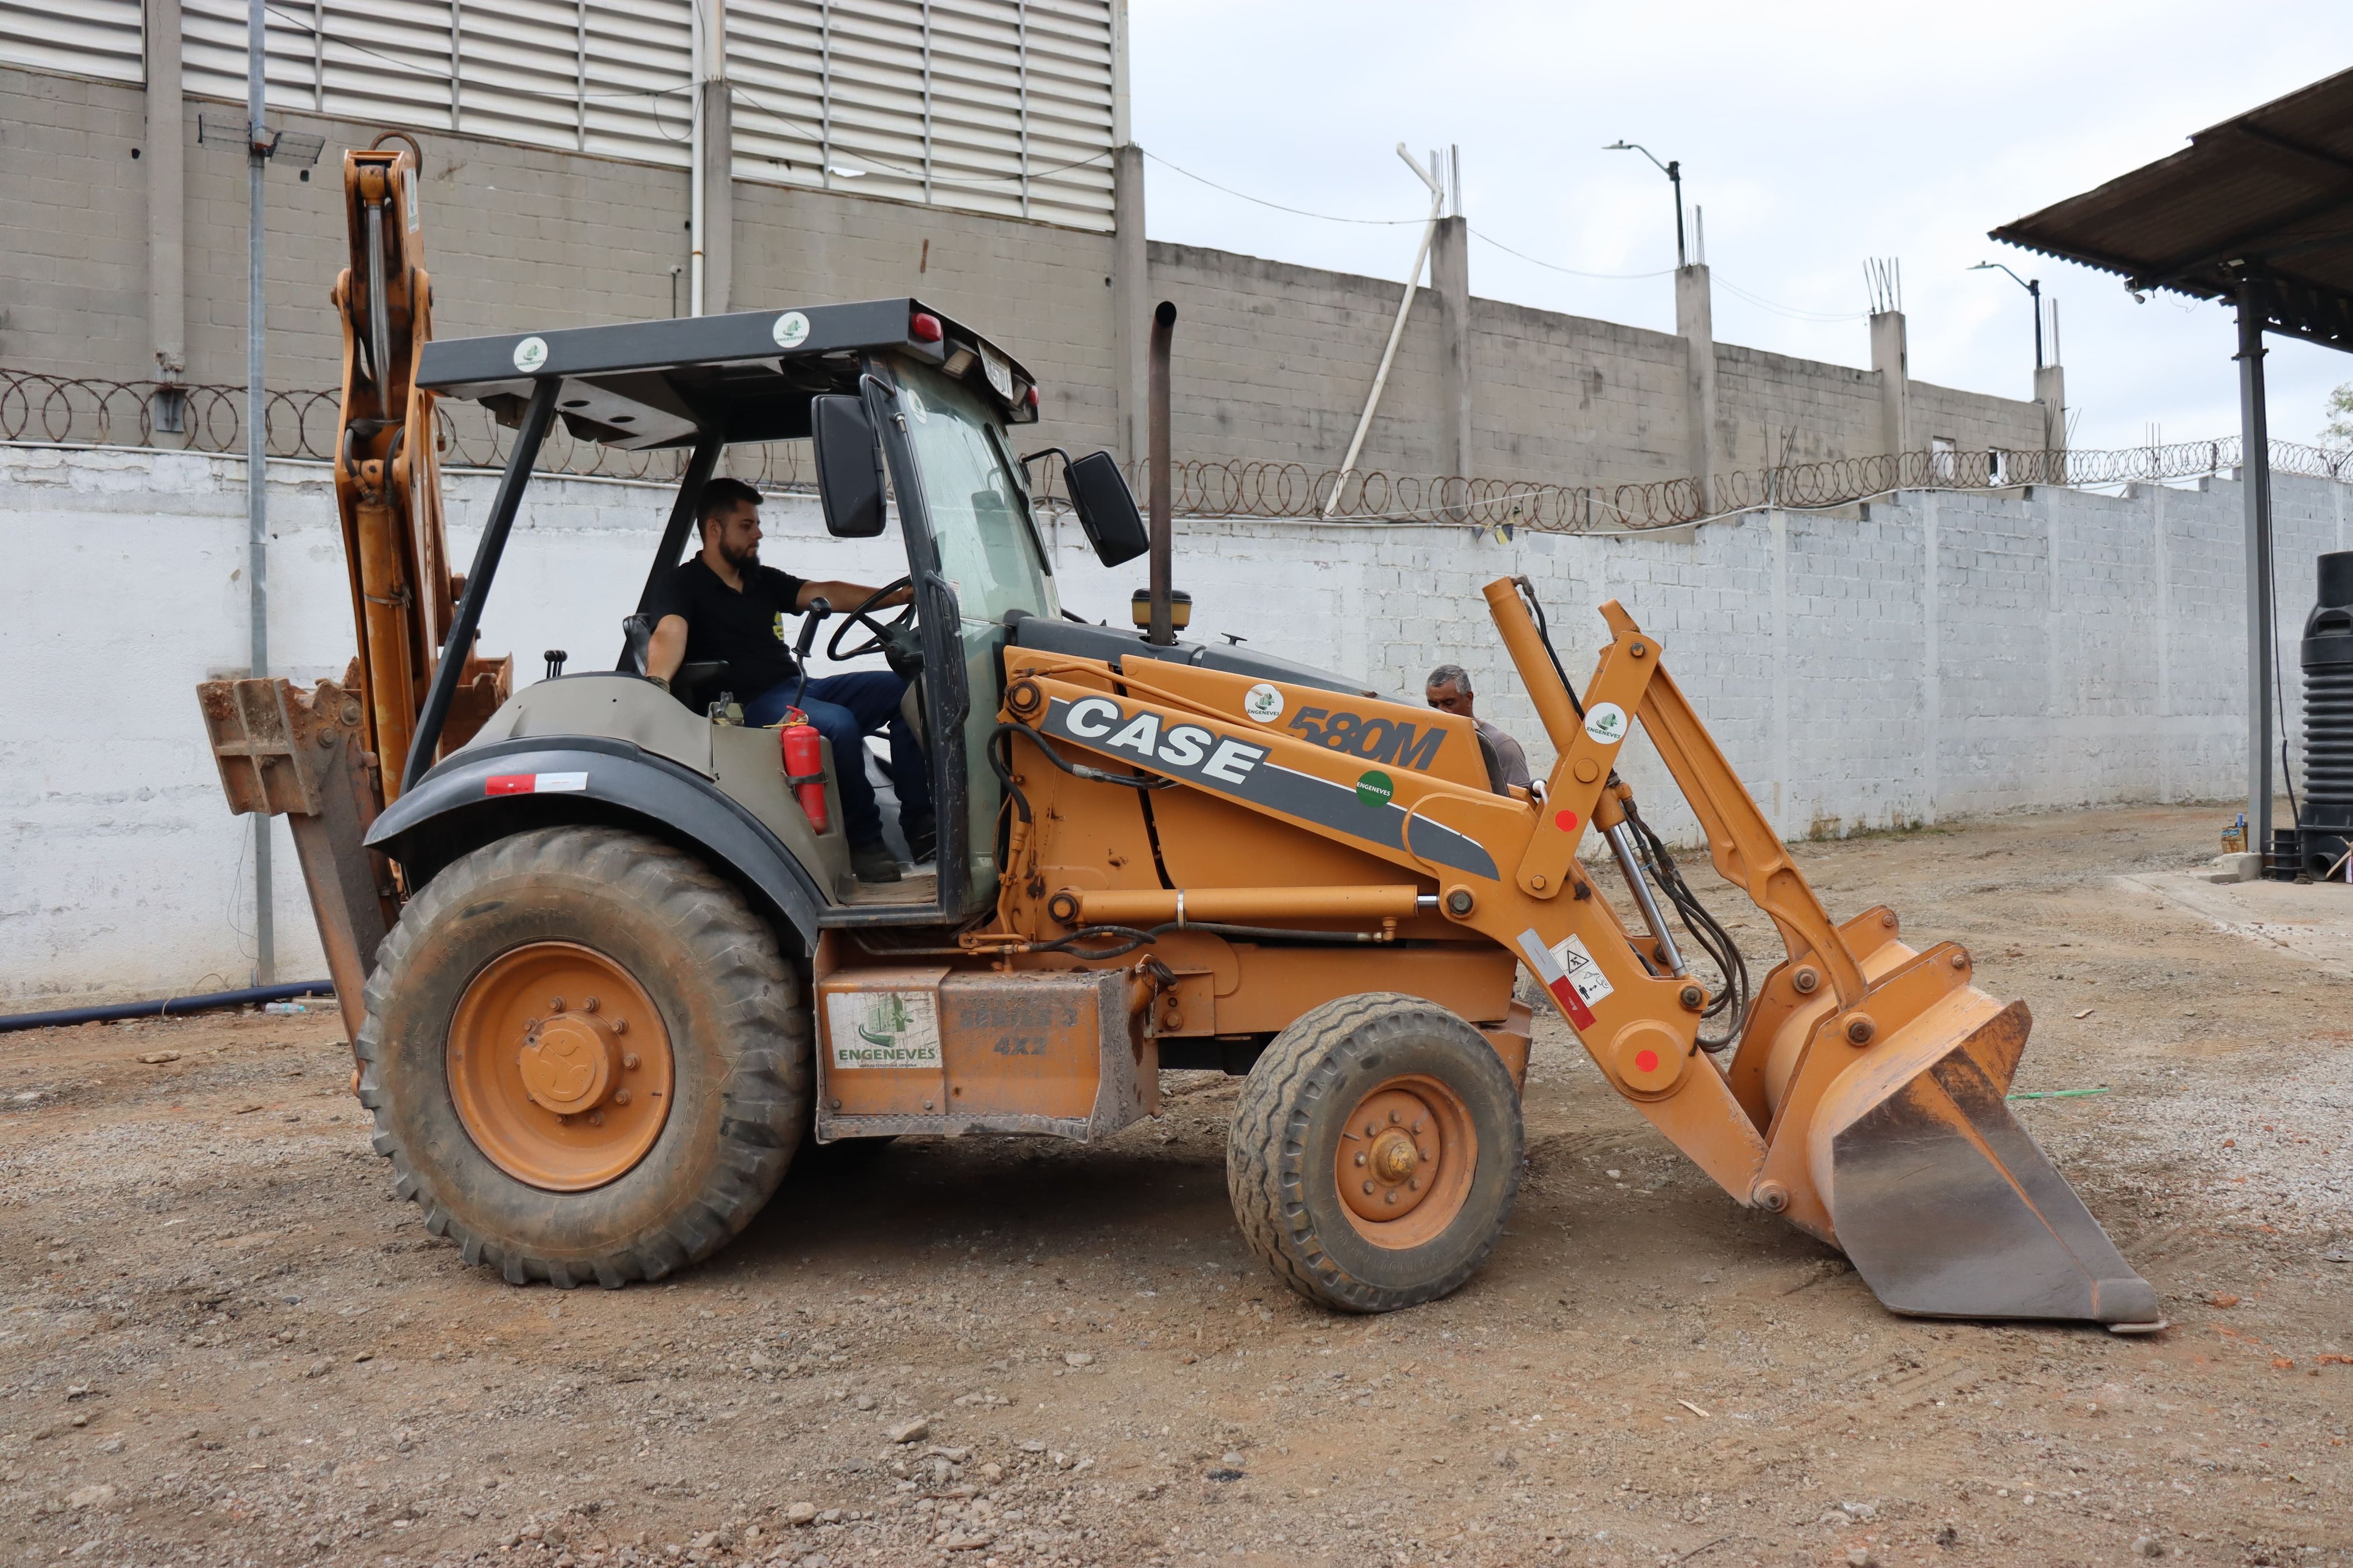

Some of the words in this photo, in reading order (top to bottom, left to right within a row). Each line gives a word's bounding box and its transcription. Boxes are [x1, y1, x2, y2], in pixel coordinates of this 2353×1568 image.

[1286, 706, 1448, 771] 580M
[1586, 727, 1621, 739] ENGENEVES
[1066, 698, 1264, 785] CASE
[1356, 782, 1391, 796] ENGENEVES
[839, 1049, 936, 1060] ENGENEVES
